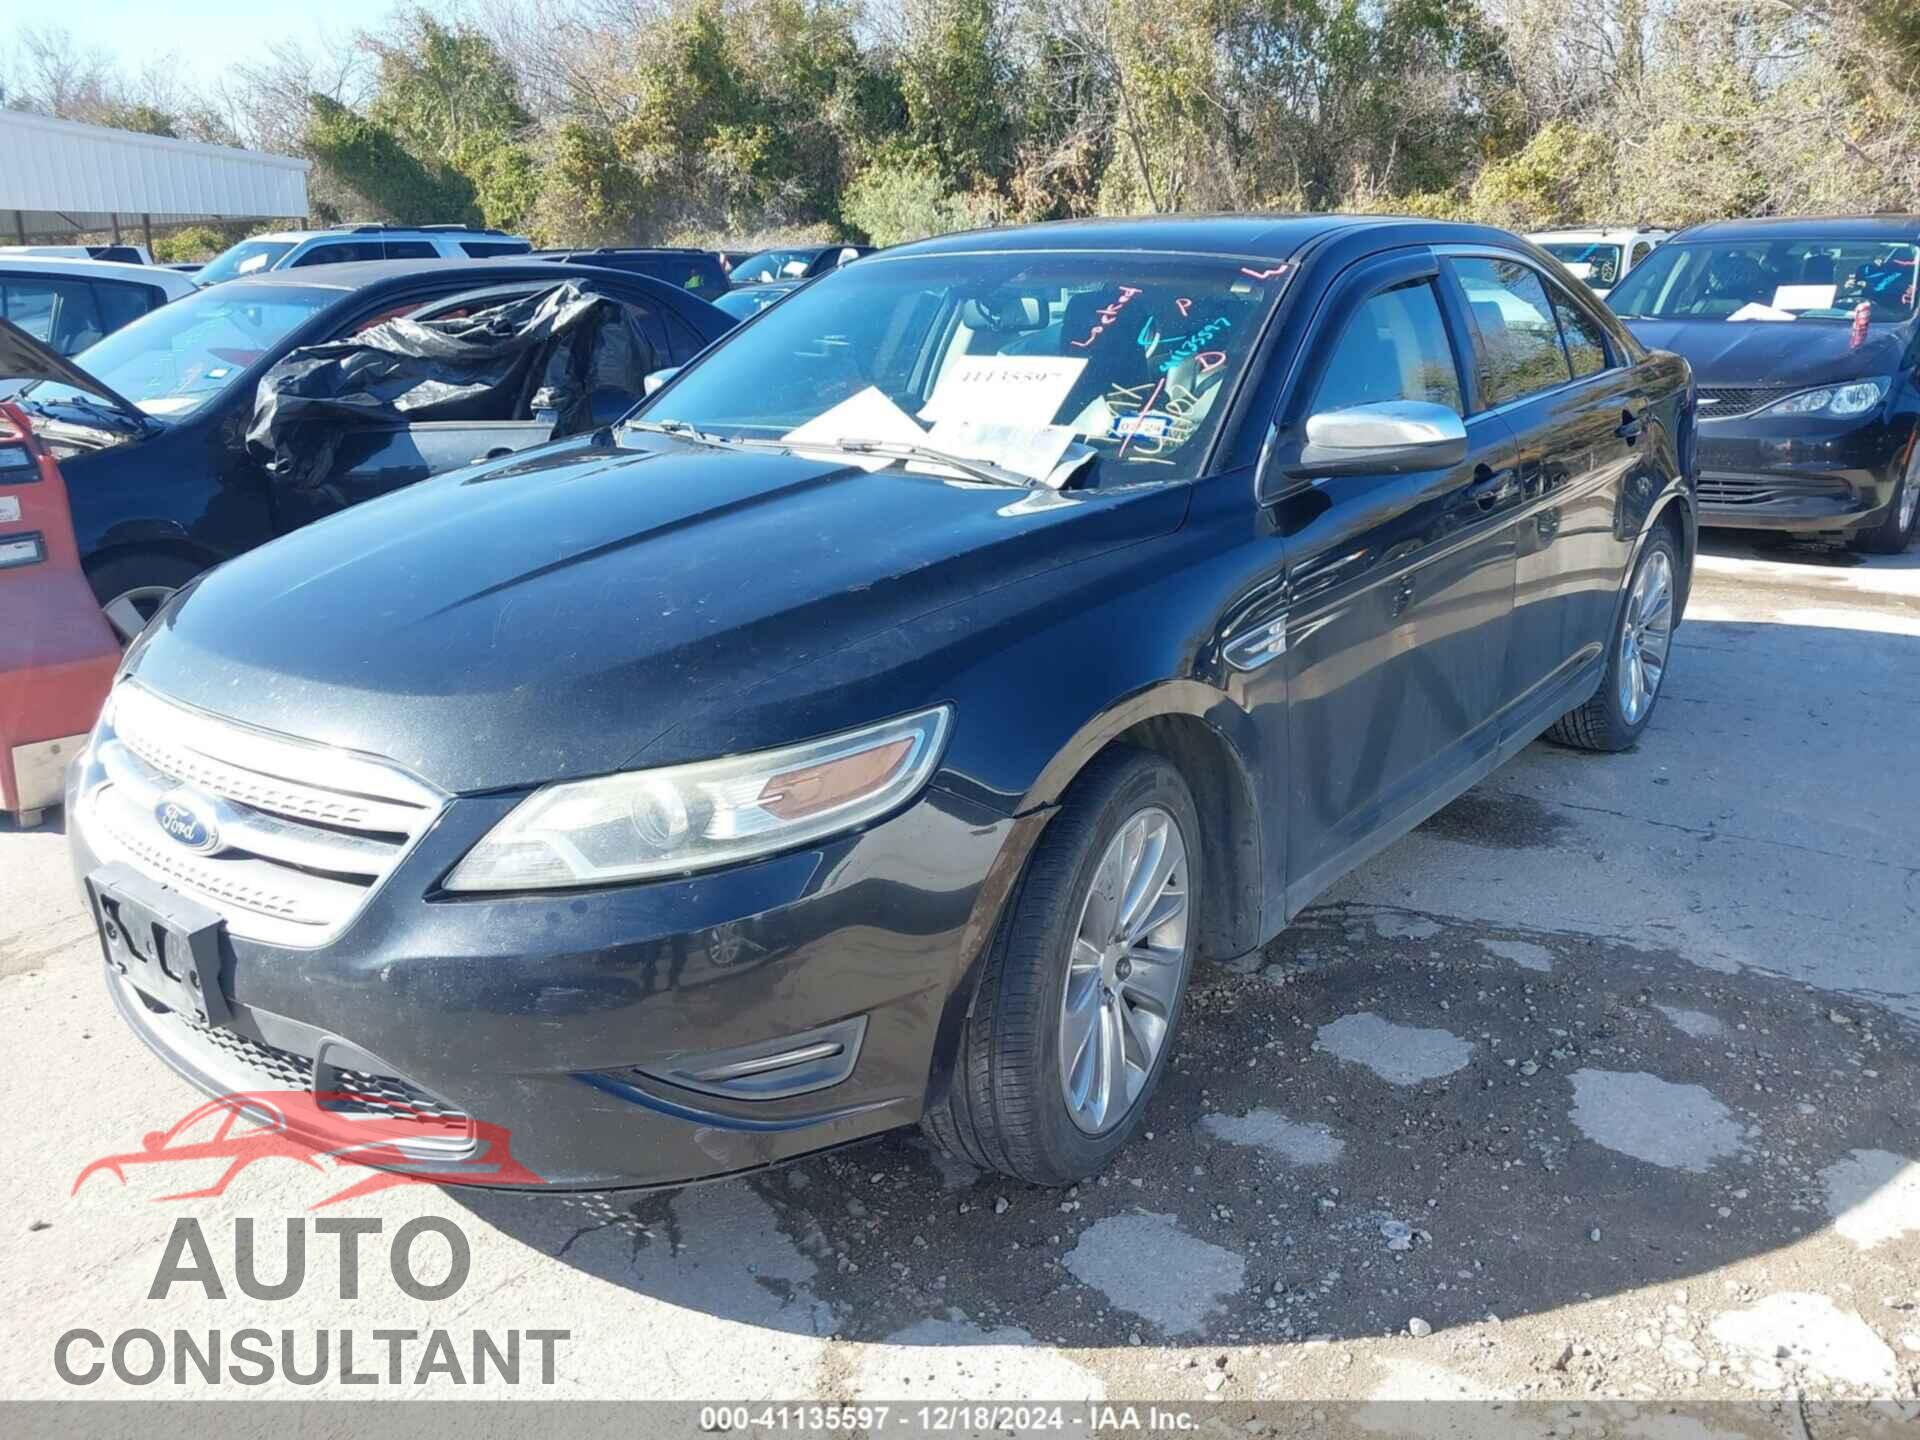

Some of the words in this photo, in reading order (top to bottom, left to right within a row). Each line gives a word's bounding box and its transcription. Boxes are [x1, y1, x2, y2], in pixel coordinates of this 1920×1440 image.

[1175, 298, 1192, 317] P
[1195, 351, 1227, 373] D
[162, 803, 197, 841] Ford
